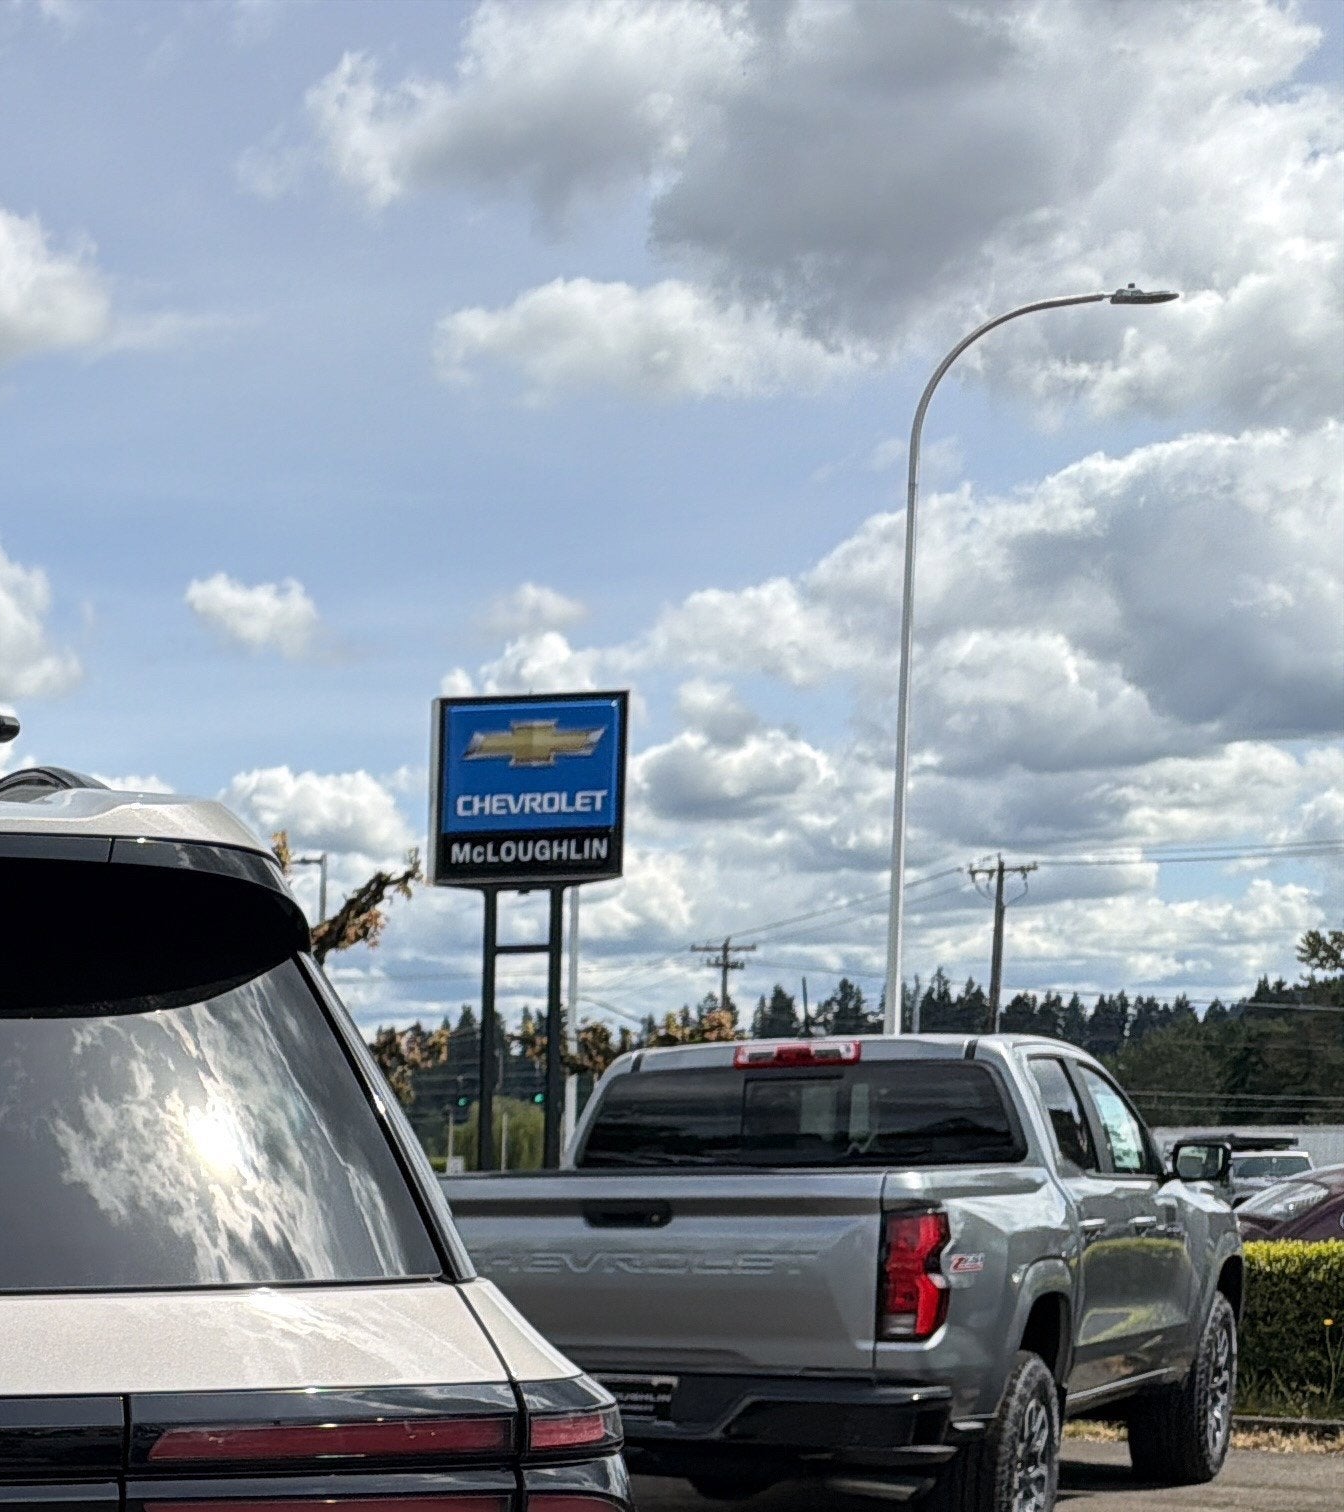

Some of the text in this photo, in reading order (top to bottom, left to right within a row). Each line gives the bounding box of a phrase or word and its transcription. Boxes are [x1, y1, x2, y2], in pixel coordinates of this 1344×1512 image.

[455, 789, 609, 817] CHEVROLET
[451, 837, 609, 865] McLOUGHLIN
[470, 1248, 818, 1276] HEVROLET
